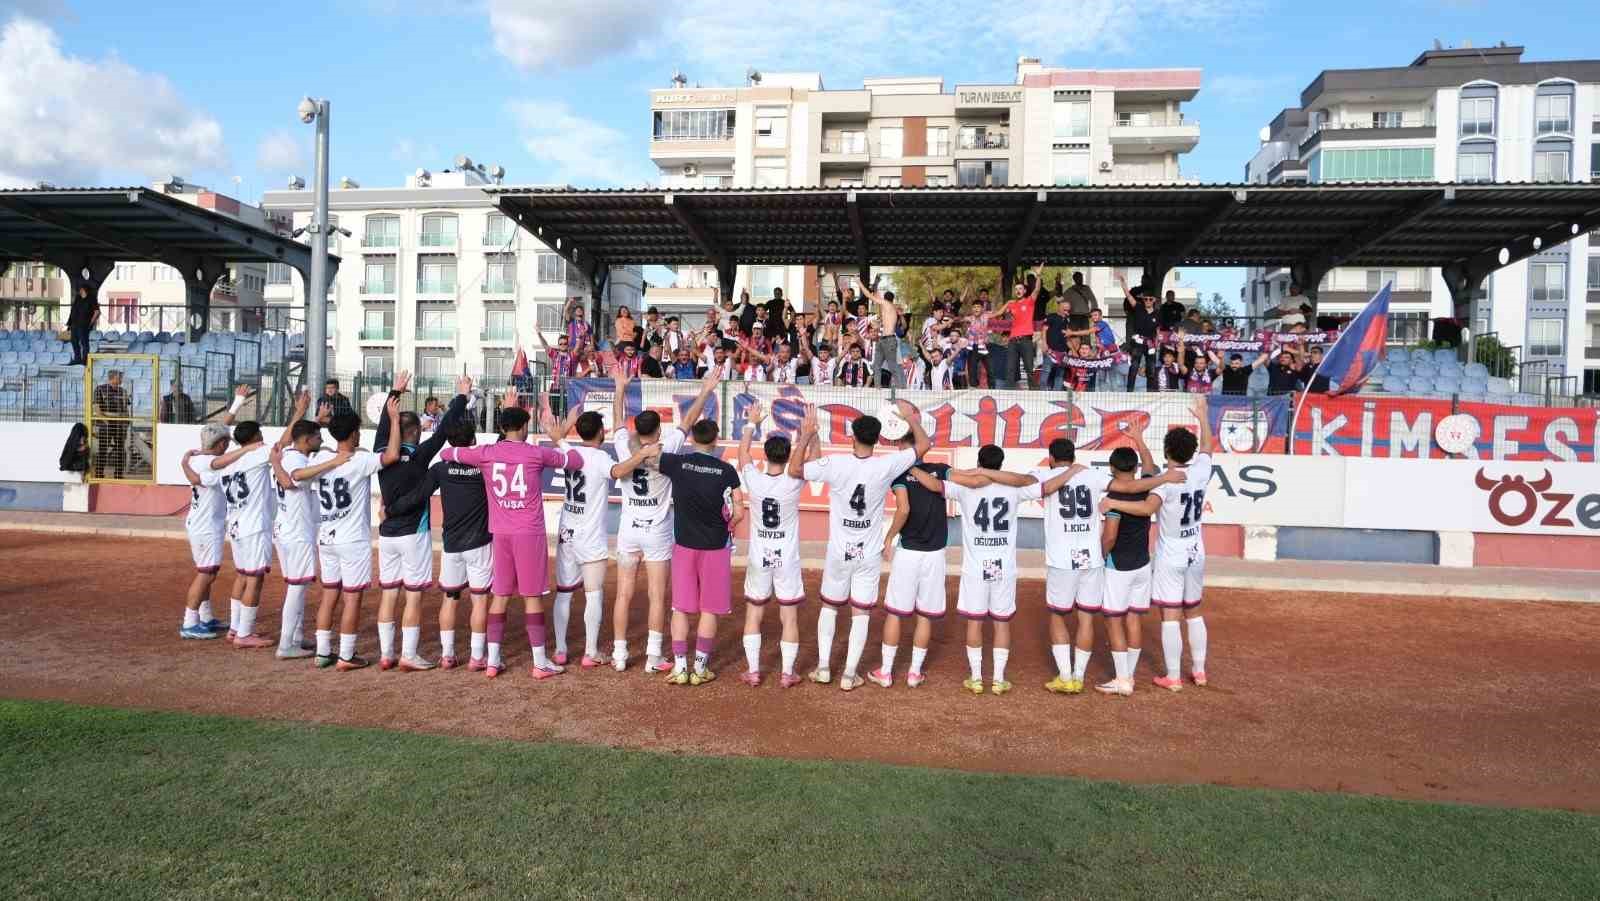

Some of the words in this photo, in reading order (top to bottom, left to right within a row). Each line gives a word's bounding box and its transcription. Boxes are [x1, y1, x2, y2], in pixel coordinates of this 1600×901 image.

[319, 477, 353, 511] 58
[491, 462, 528, 498] 54
[632, 468, 649, 496] 5
[761, 497, 781, 530] 8
[849, 483, 867, 517] 4
[973, 496, 1010, 533] 42
[1058, 484, 1093, 519] 99
